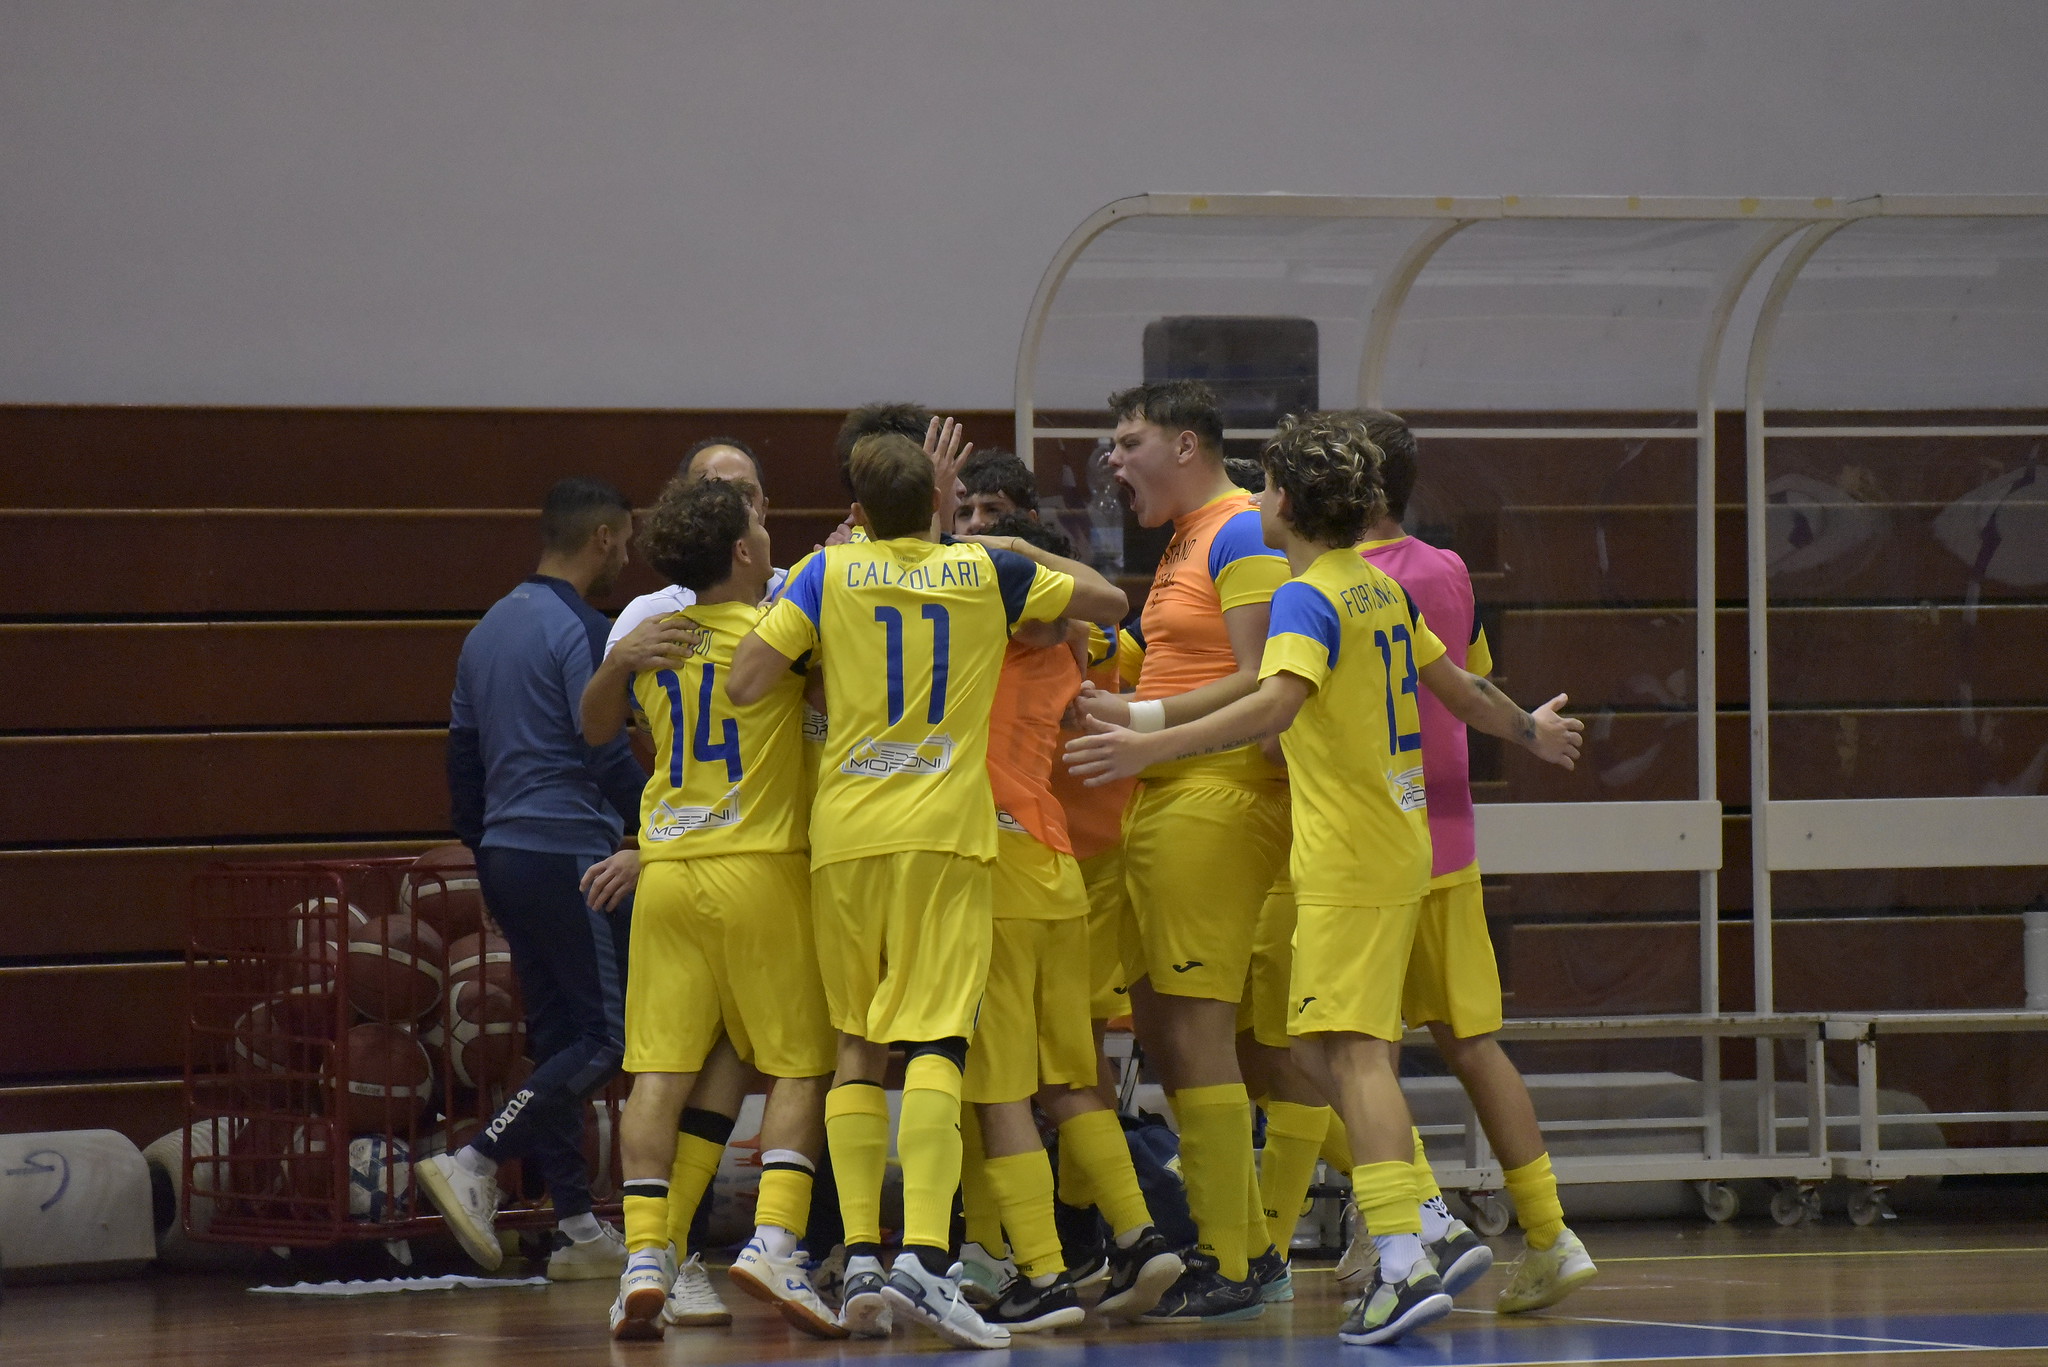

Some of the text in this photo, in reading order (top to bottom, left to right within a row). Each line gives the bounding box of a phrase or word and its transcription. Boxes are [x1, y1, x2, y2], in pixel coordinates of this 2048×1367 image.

[847, 561, 979, 590] CALZOLARI
[656, 662, 743, 789] 14
[874, 603, 950, 727] 11
[1374, 623, 1422, 756] 13
